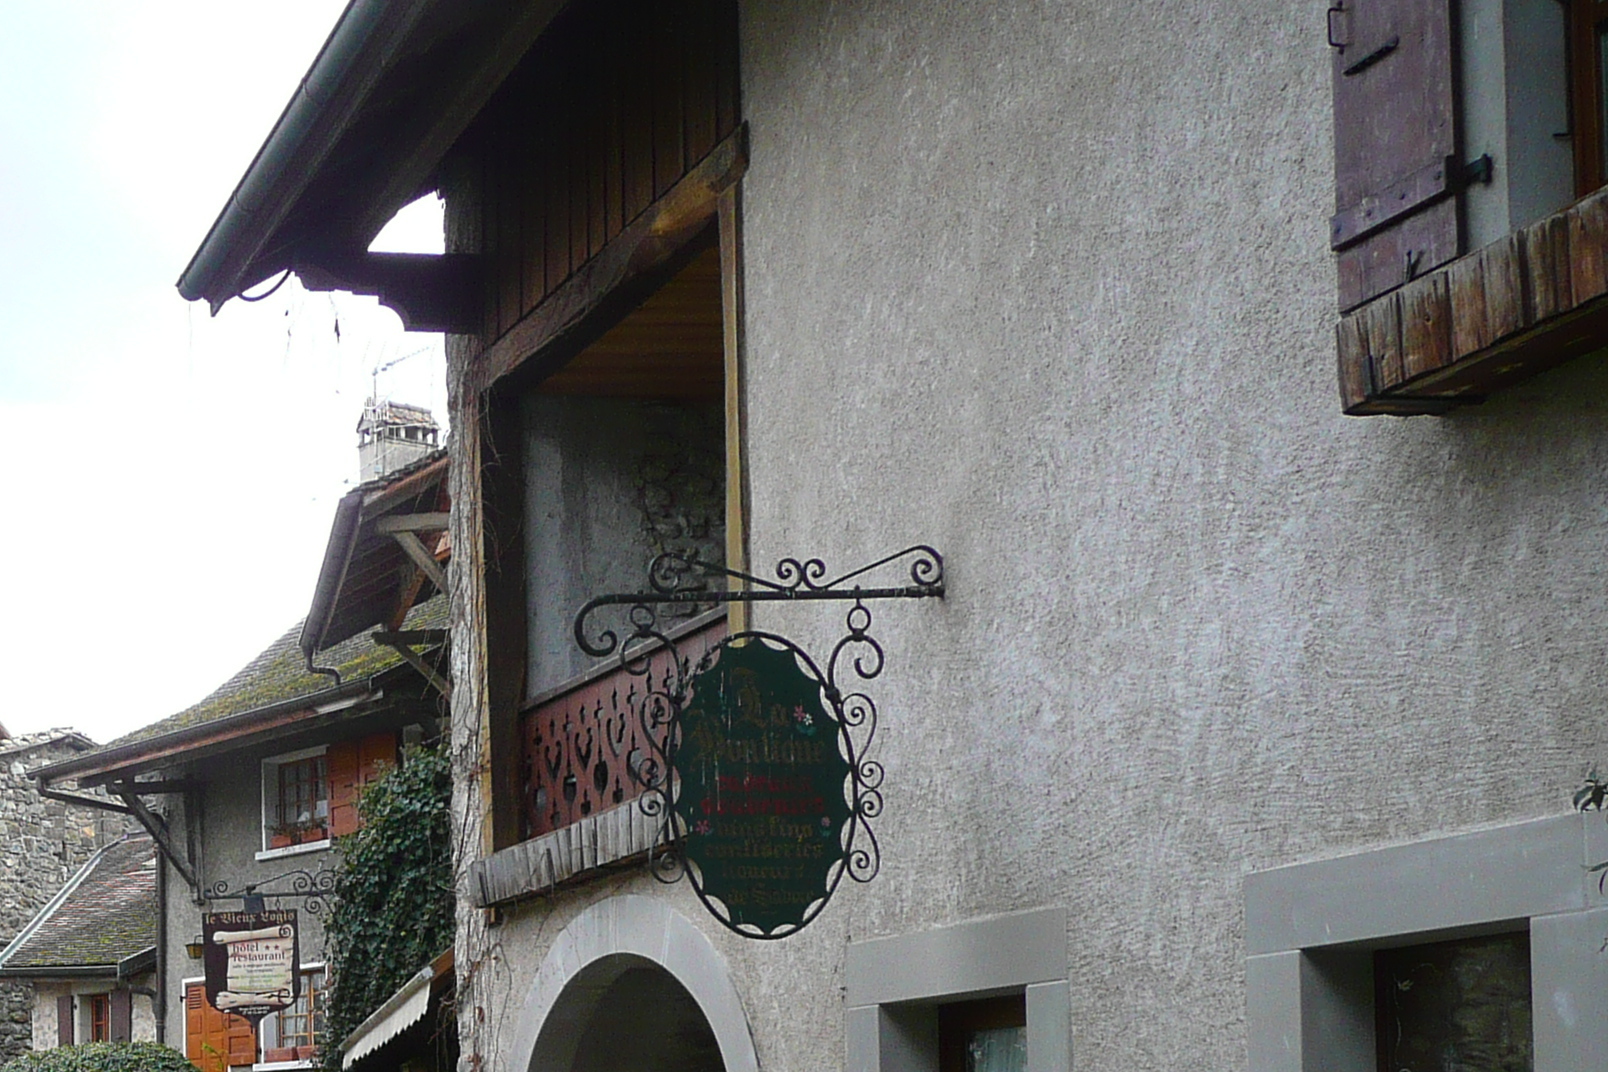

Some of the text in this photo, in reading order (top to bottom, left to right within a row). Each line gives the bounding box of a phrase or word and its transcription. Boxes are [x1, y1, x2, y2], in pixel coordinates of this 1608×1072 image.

[220, 913, 258, 924] Vieux
[260, 911, 295, 924] Logis
[232, 941, 259, 953] hôtel
[232, 951, 285, 962] restaurant
